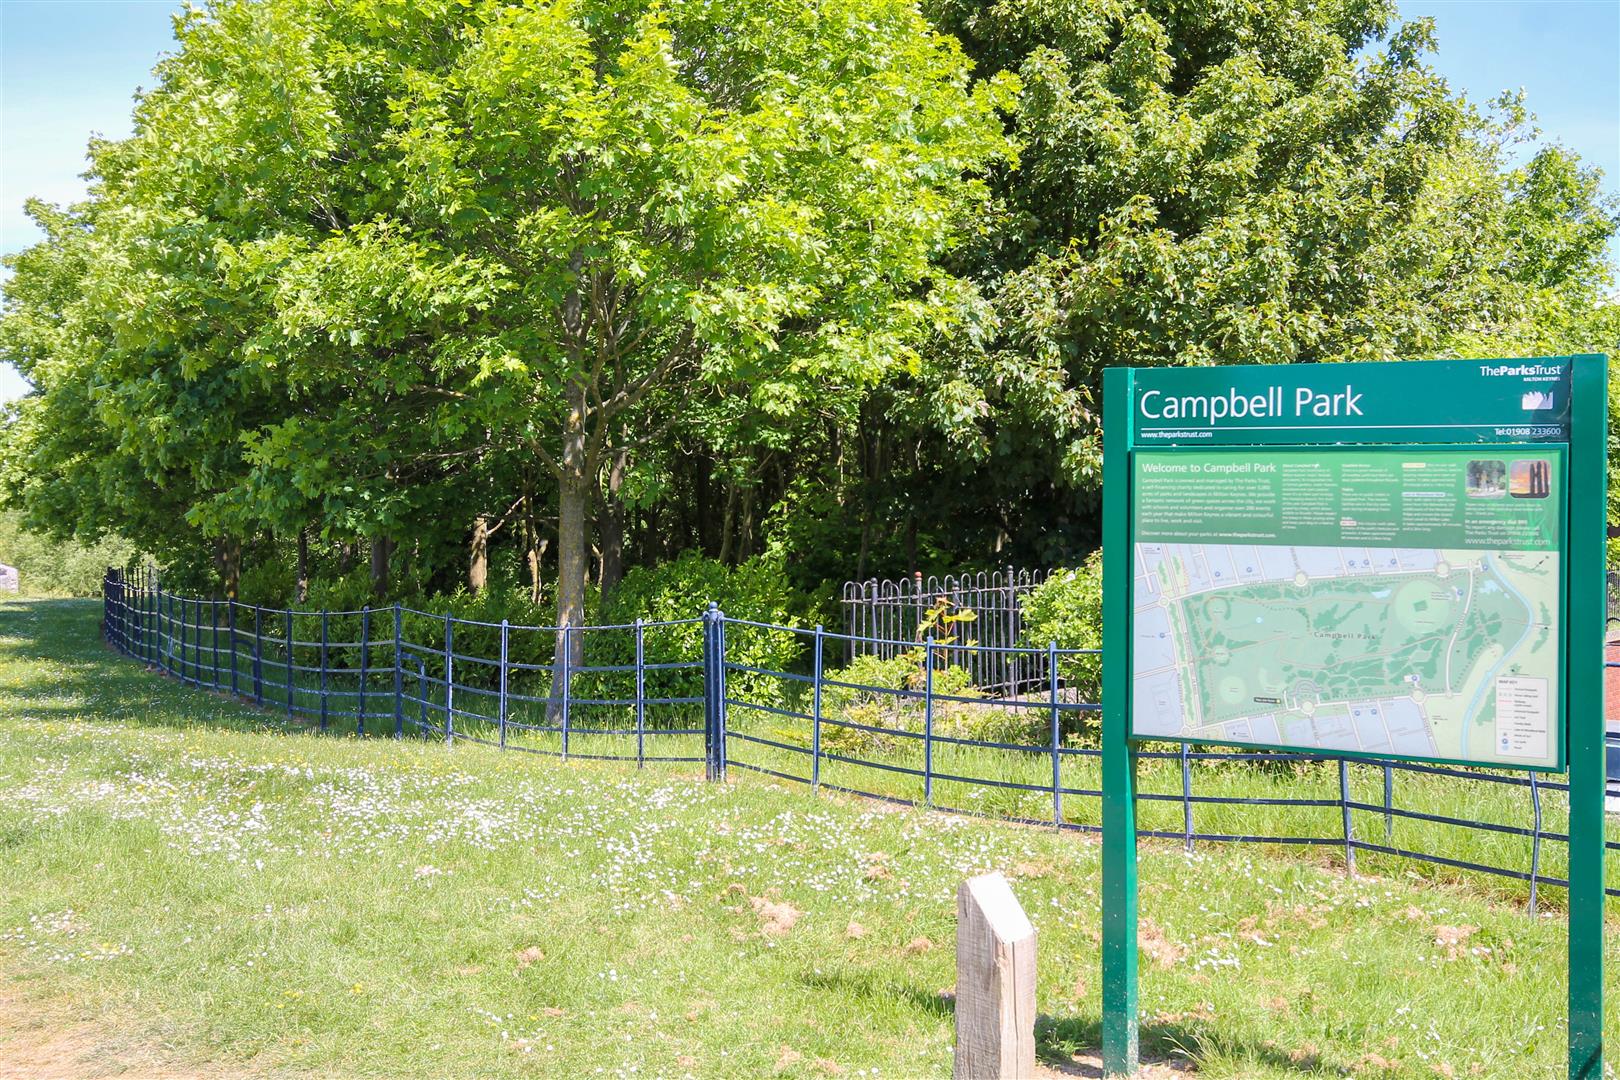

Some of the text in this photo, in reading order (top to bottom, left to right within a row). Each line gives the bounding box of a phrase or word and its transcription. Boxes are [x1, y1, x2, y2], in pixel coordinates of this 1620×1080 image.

[1480, 365, 1561, 376] TheParksTrust
[1140, 384, 1364, 425] Campbell Park
[1532, 428, 1561, 436] 233600
[1142, 463, 1276, 475] Welcome to Campbell Park
